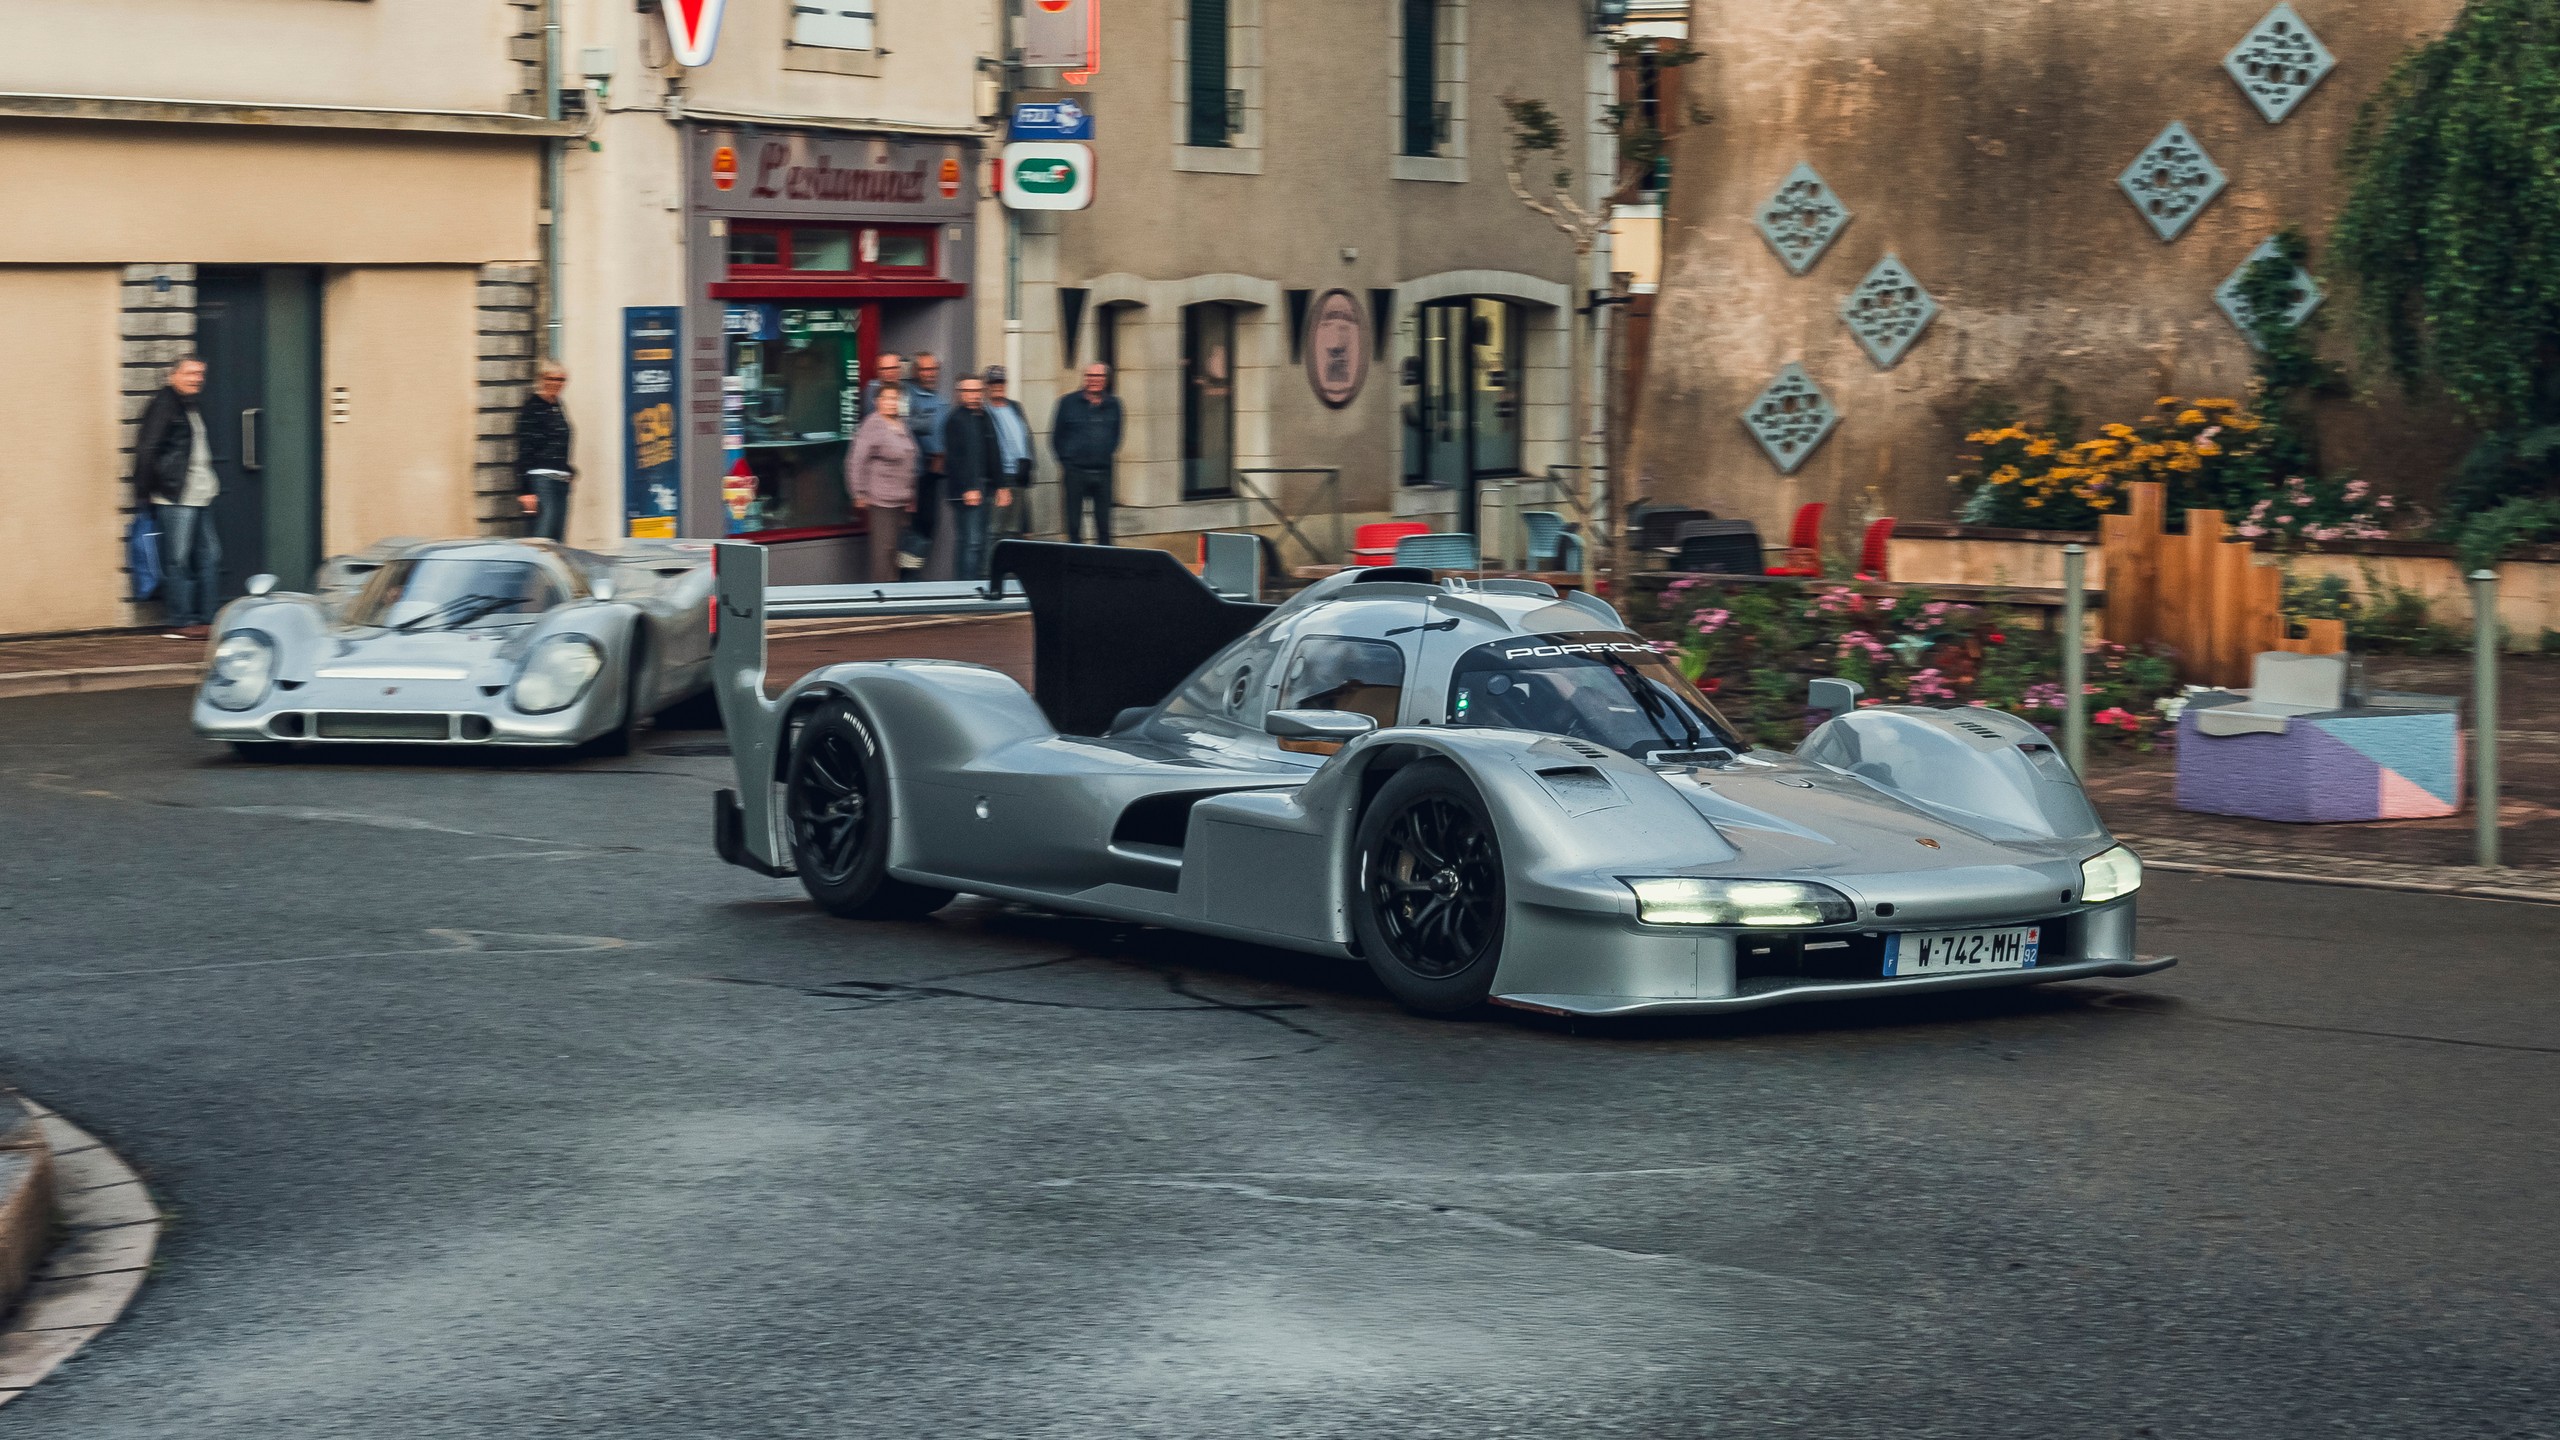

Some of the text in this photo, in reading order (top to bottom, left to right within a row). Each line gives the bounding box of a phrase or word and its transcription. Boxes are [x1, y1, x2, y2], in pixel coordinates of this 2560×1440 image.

[843, 711, 875, 757] MICHELIN
[1887, 933, 2037, 968] F W-742-MH 92
